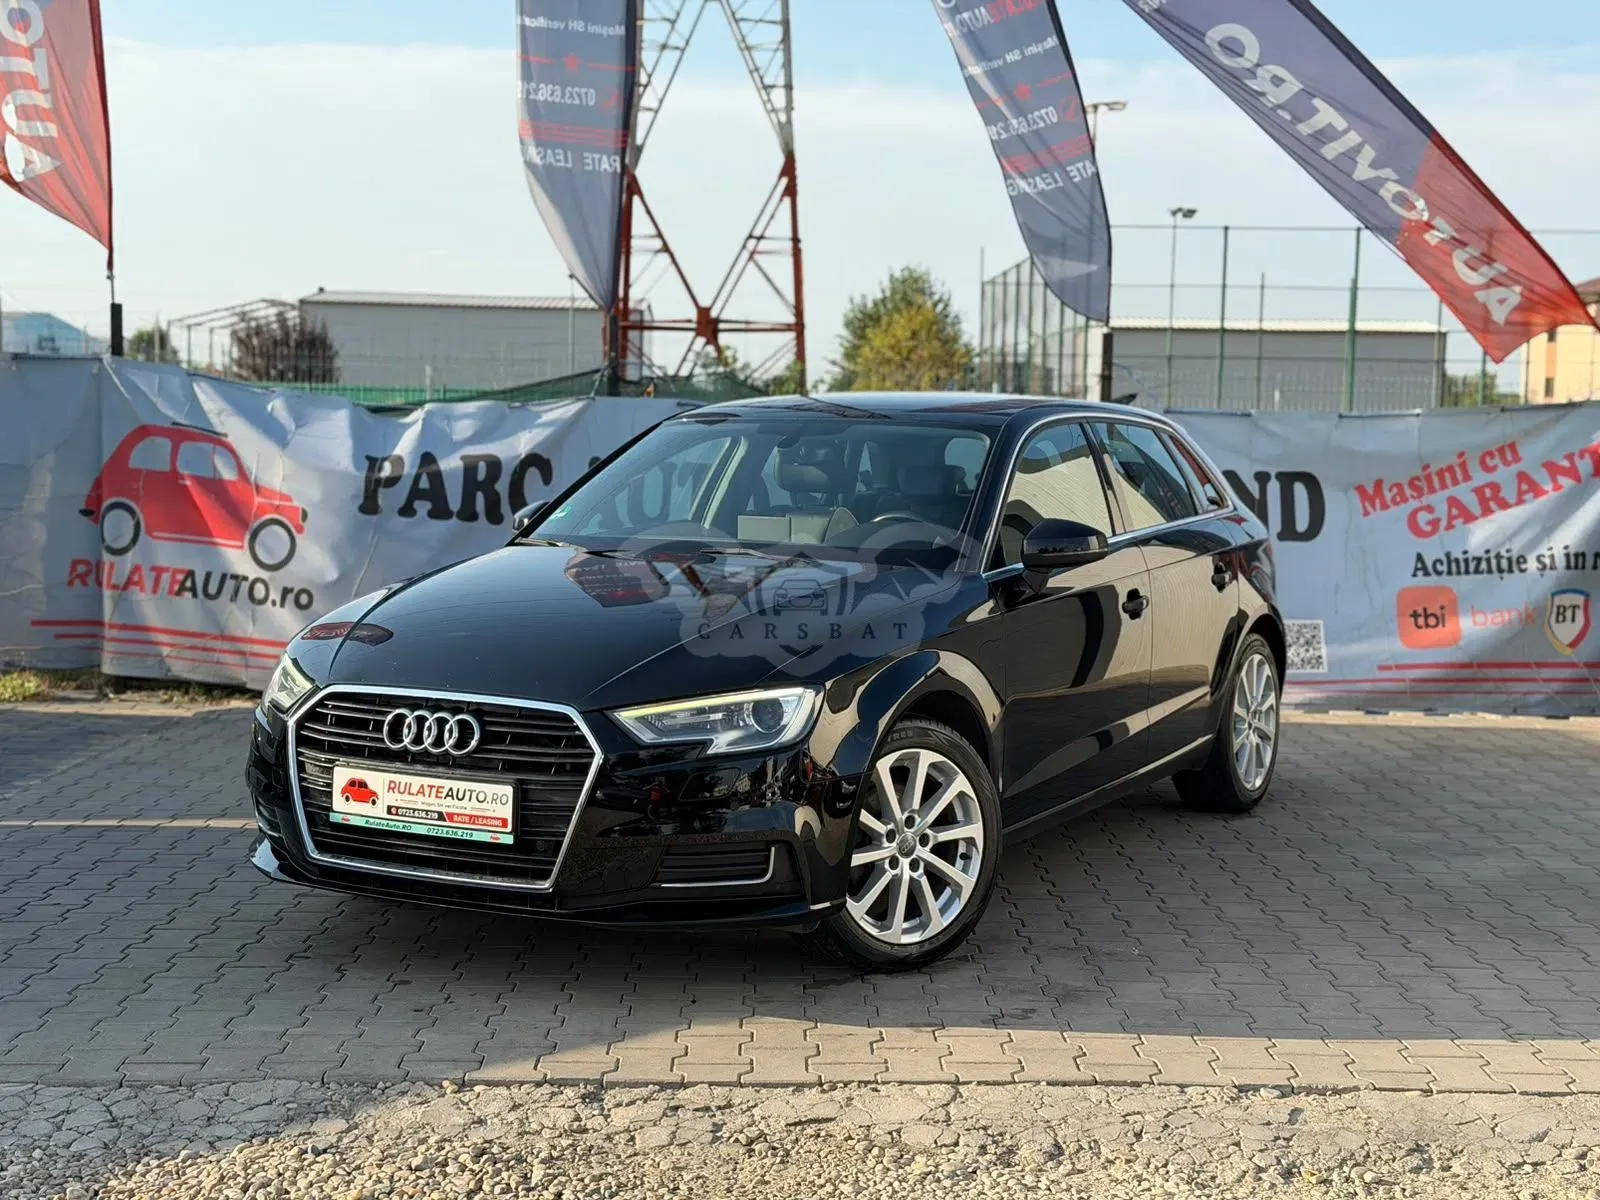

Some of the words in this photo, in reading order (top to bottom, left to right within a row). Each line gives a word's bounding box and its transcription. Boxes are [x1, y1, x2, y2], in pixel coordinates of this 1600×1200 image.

[1479, 440, 1523, 478] cu
[357, 451, 553, 525] PARC
[1222, 469, 1326, 542] ND
[1411, 549, 1528, 581] Achiziție
[1535, 547, 1557, 578] și
[1409, 605, 1447, 630] tbi
[1470, 602, 1537, 629] bank
[1554, 603, 1581, 624] BT
[387, 780, 509, 806] RULATEAUTO.RO
[398, 809, 438, 820] 0723.636.219
[453, 814, 469, 823] RATE
[475, 816, 502, 826] LEASING
[364, 819, 412, 831] RulateAuto.RO
[427, 827, 473, 839] 0723.636.219
